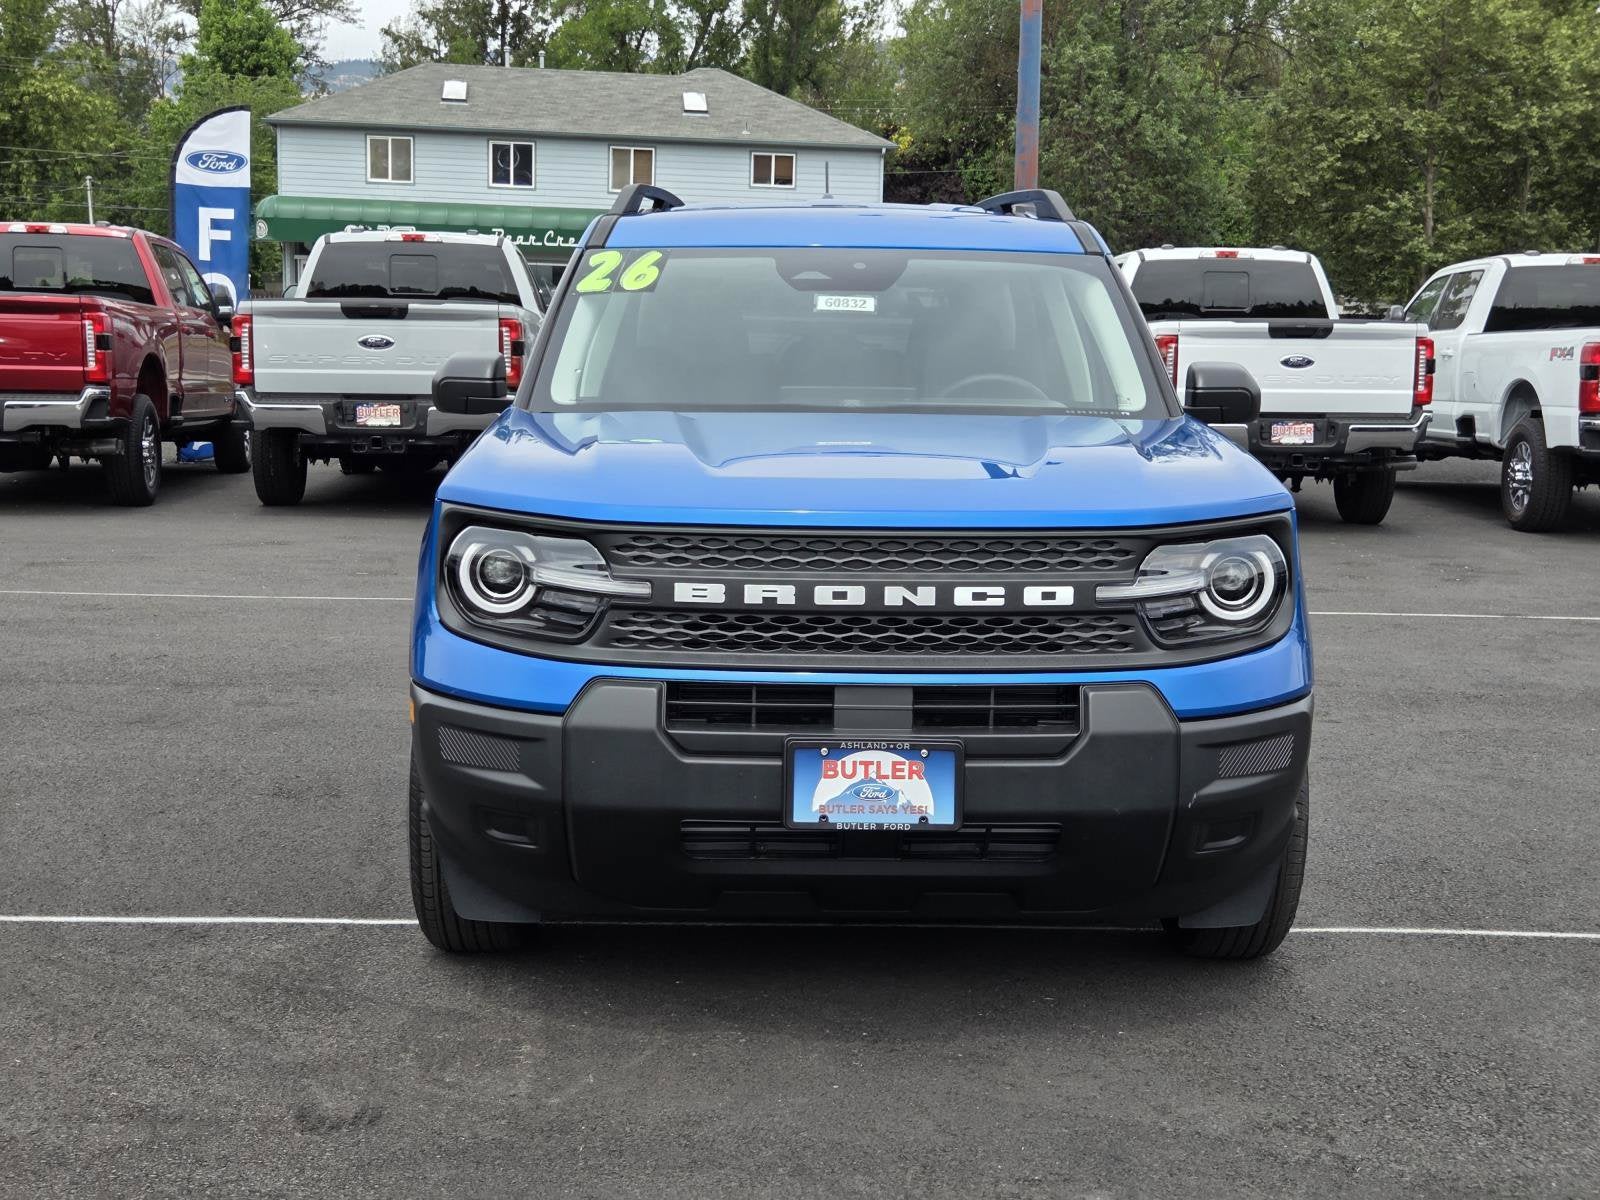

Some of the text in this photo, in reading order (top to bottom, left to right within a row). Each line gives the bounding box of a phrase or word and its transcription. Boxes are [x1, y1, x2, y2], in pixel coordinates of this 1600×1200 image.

[198, 153, 237, 171] Ford
[543, 230, 580, 246] Cre
[575, 250, 663, 293] 26
[824, 297, 868, 310] 60832
[1550, 346, 1575, 361] FX4
[395, 356, 450, 366] DU
[358, 408, 399, 417] BUTLER
[1273, 426, 1313, 436] BUTLER
[674, 582, 1075, 607] BRONCO
[839, 742, 911, 751] ASHLAND OR
[822, 759, 926, 781] BUTLER
[859, 786, 888, 800] Ford
[818, 804, 929, 815] BUTLER SAYS YES!
[836, 822, 911, 831] BUTLER FORD
